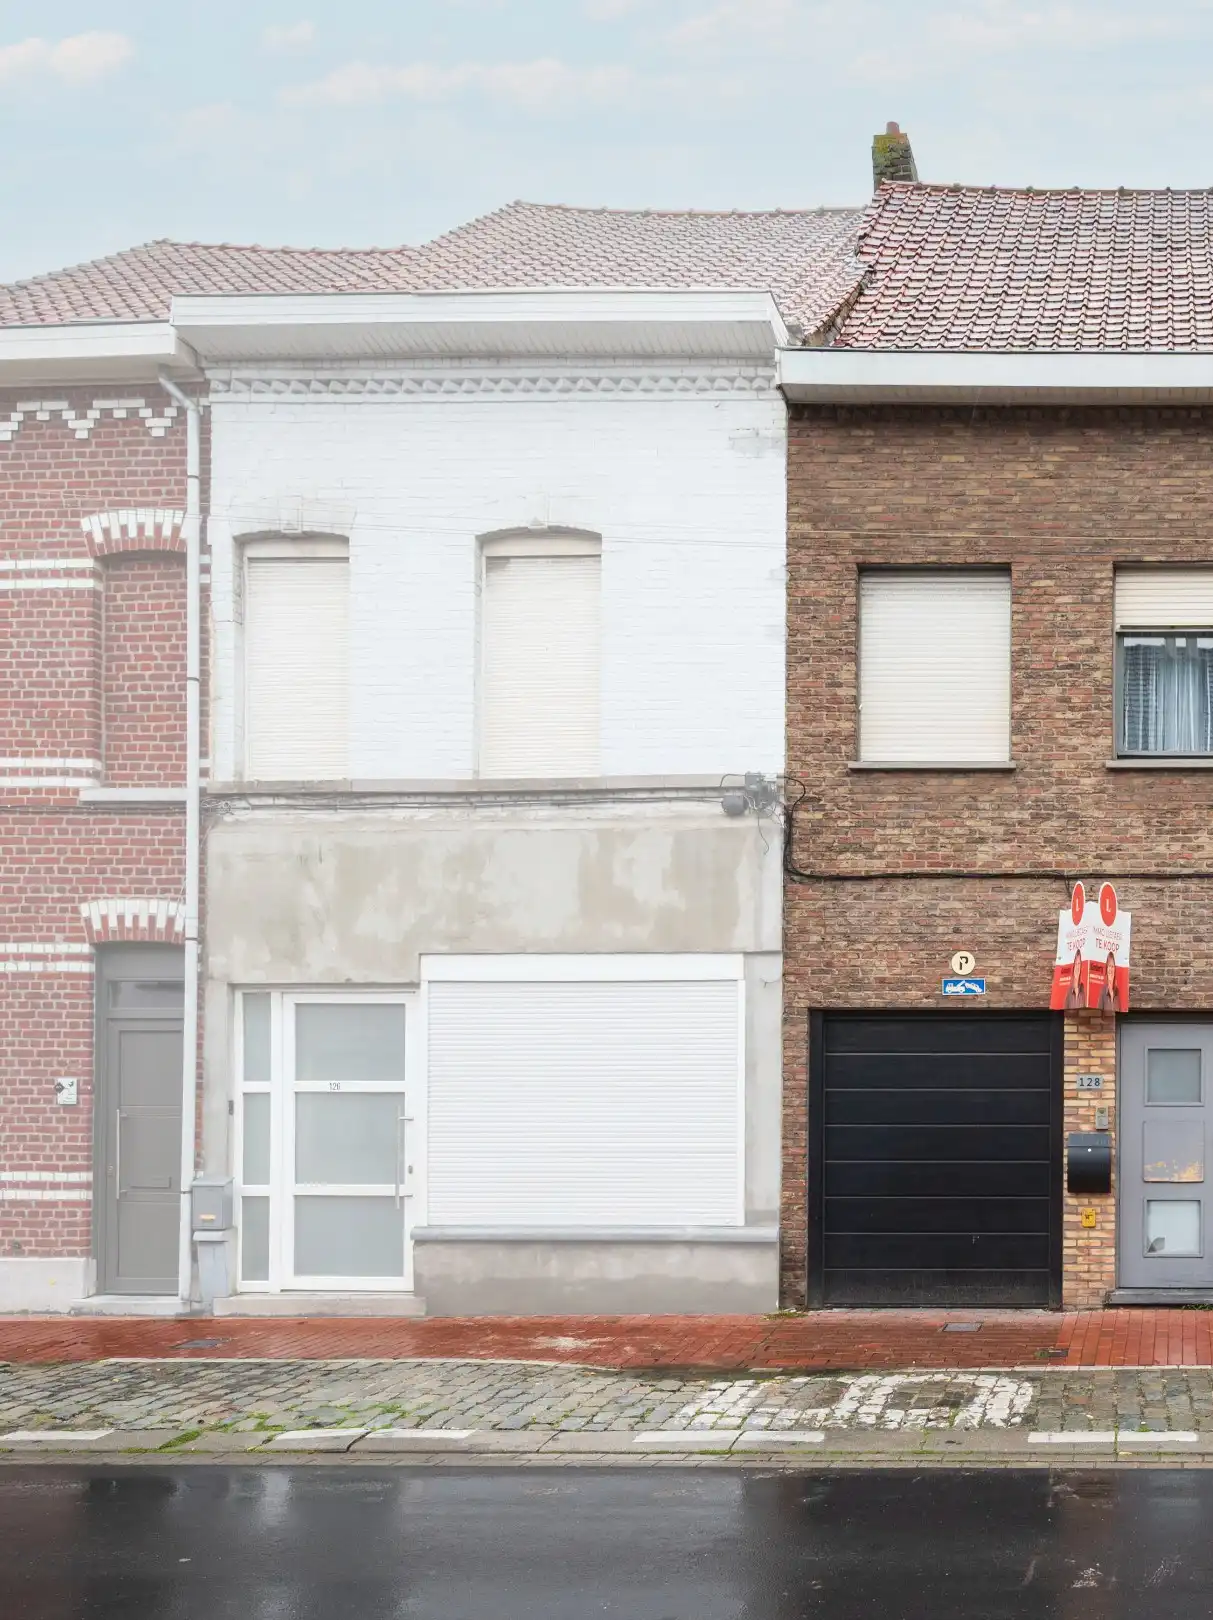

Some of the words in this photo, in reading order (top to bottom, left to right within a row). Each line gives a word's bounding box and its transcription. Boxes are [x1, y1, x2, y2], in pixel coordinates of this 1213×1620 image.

[1095, 937, 1103, 949] TE
[1103, 939, 1120, 953] KOOP
[1079, 1077, 1101, 1087] 128
